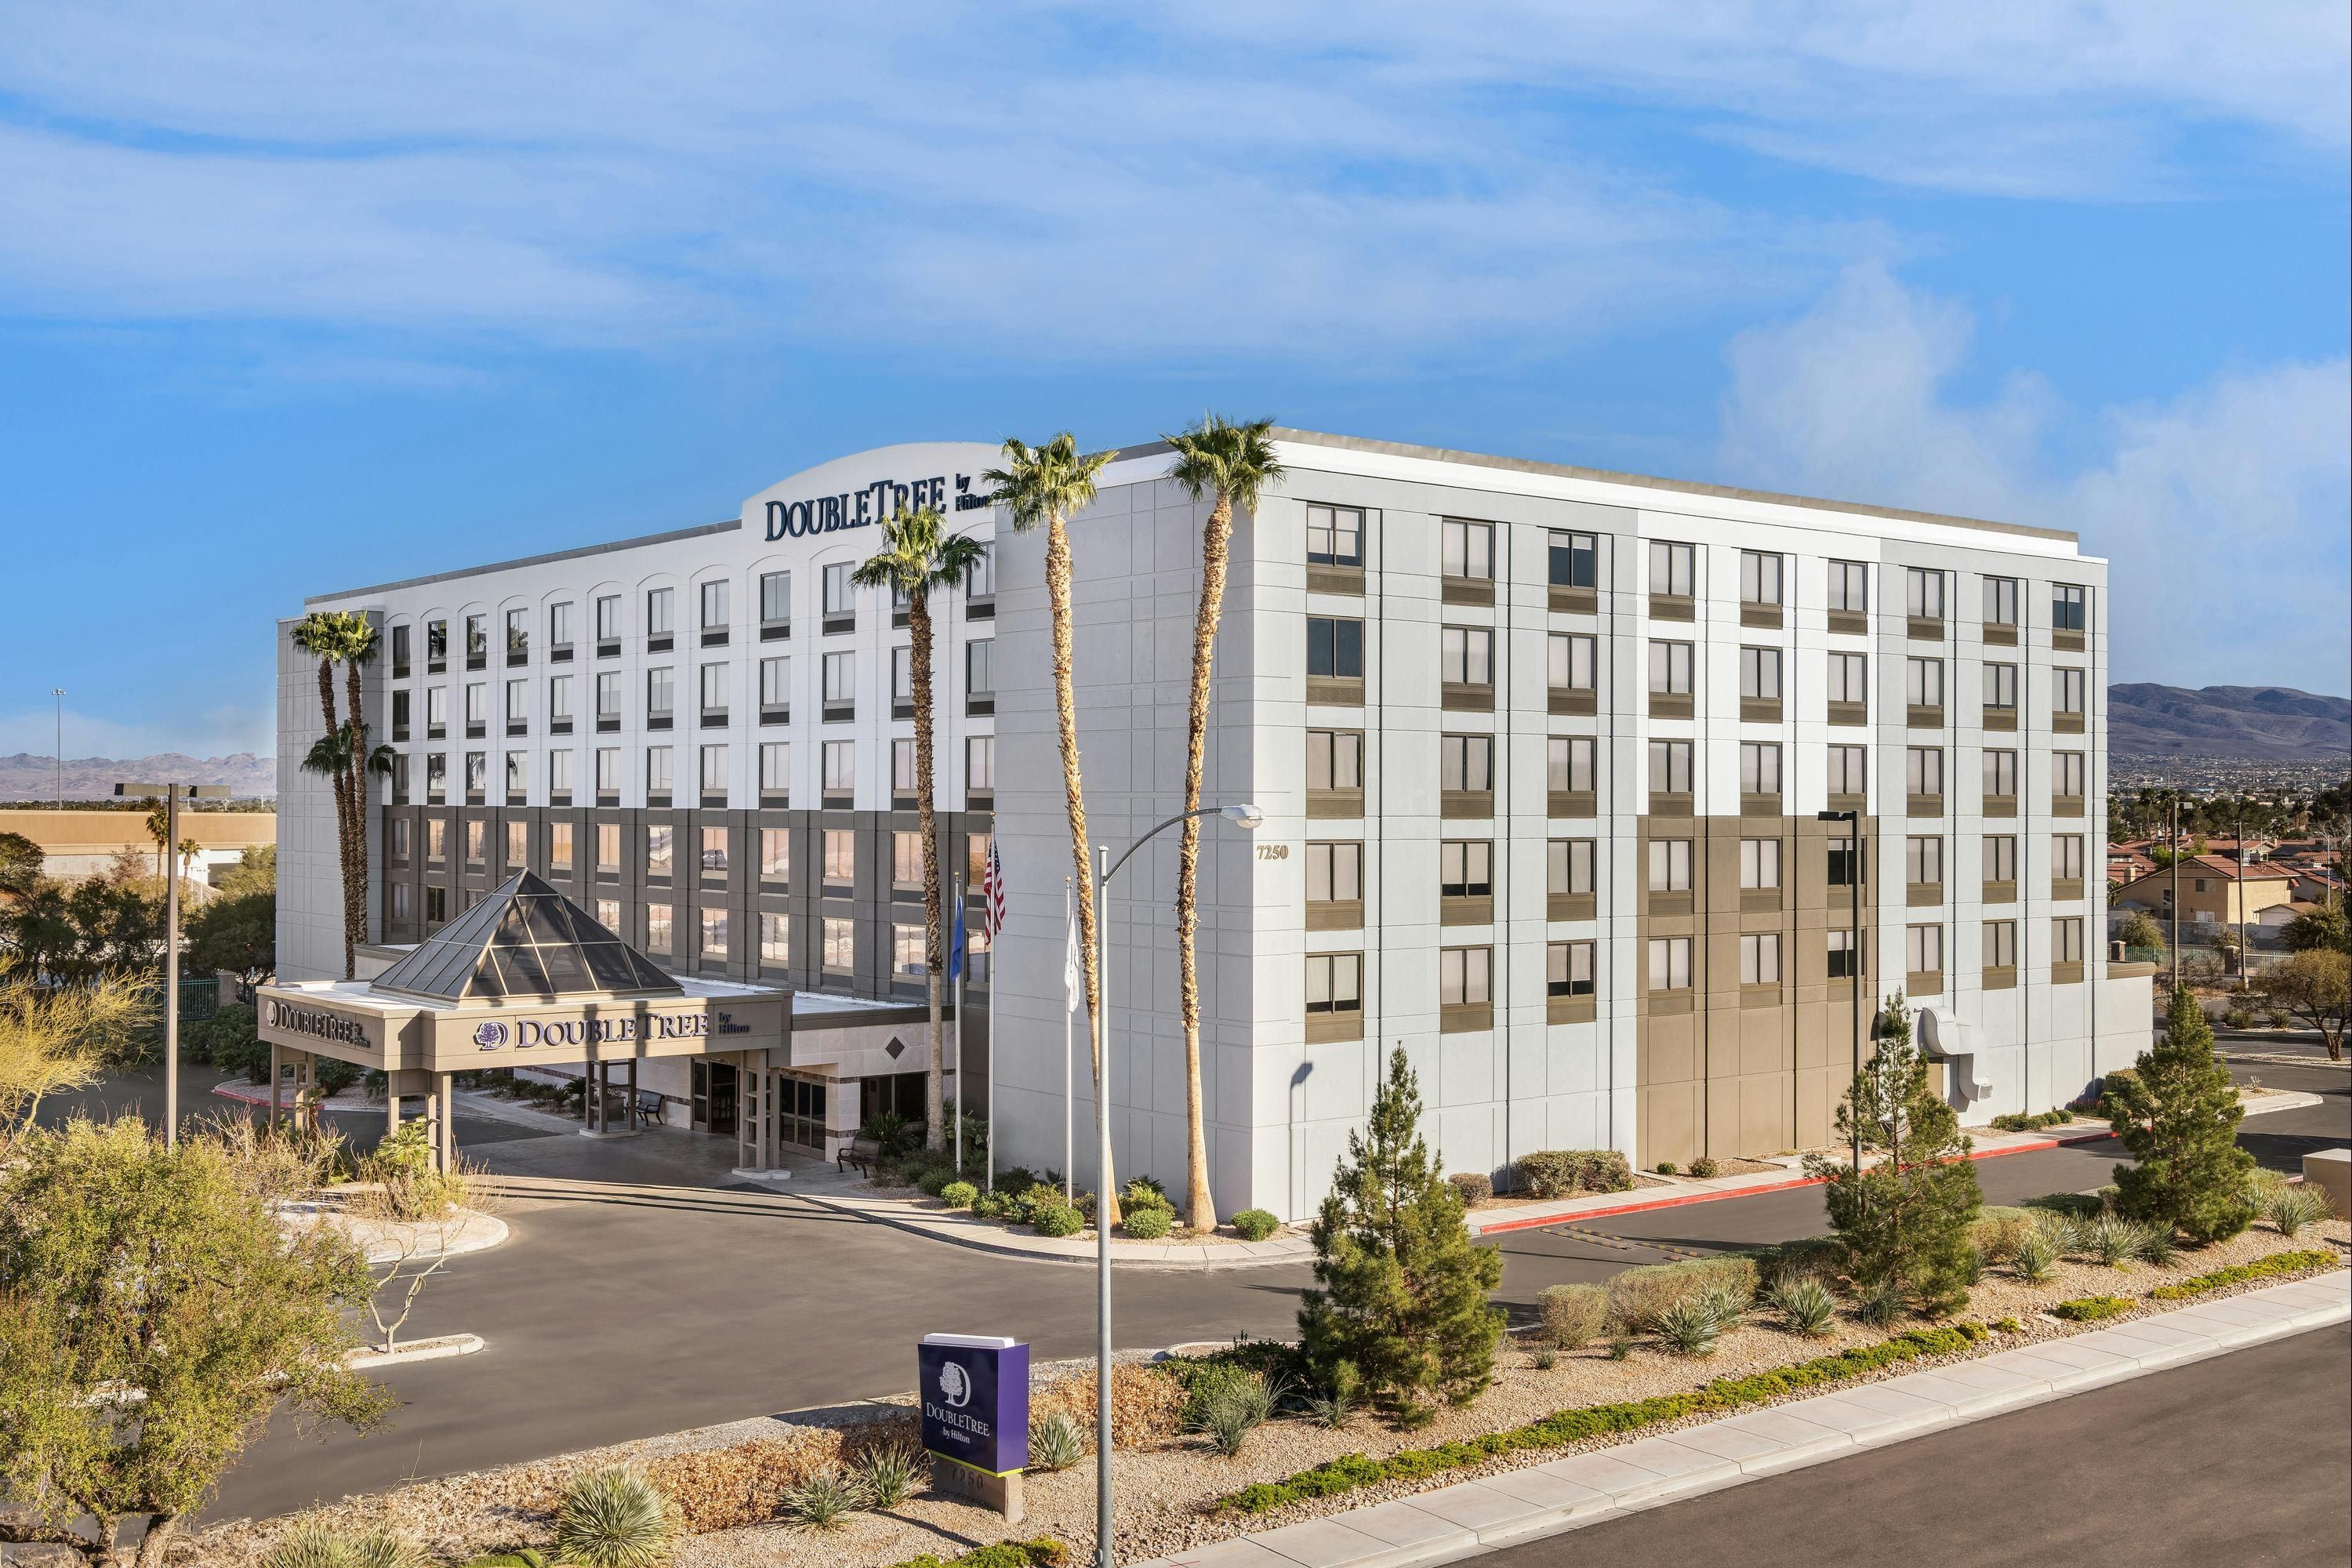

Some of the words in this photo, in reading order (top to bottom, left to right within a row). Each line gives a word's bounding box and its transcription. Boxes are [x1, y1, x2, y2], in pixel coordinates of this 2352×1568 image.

[955, 473, 971, 493] by
[1257, 844, 1289, 859] 7250
[280, 1004, 350, 1044] DOUBLETREE
[517, 1012, 710, 1048] DOUBLETREE
[927, 1402, 990, 1437] DOUBLETREE
[942, 1426, 950, 1439] by
[951, 1429, 971, 1444] Hilton
